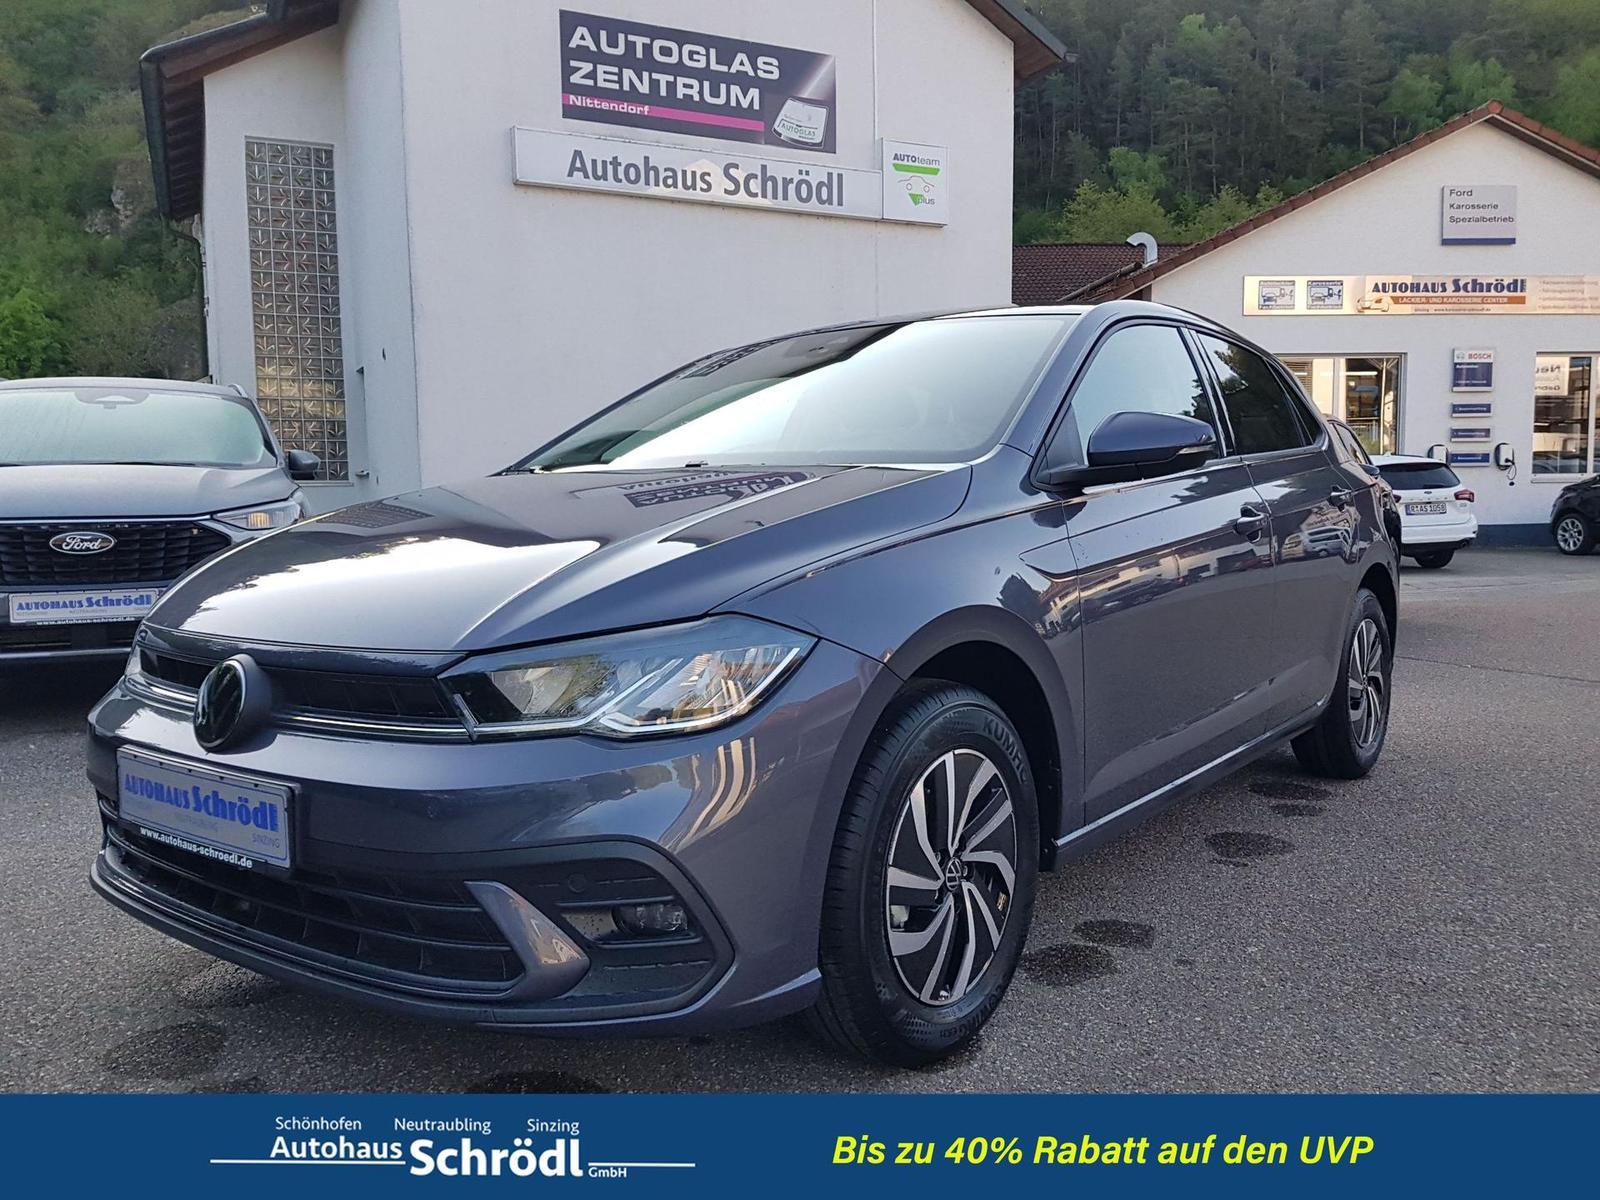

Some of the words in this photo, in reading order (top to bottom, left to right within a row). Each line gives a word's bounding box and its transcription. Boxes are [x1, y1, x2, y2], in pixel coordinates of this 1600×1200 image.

[568, 26, 780, 80] AUTOGLAS
[569, 60, 760, 111] ZENTRUM
[569, 94, 650, 116] Nittendorf
[567, 149, 713, 194] Autohaus
[723, 162, 845, 208] Schrödl
[1449, 189, 1473, 198] Ford
[1449, 202, 1499, 211] Karosserie
[1449, 215, 1515, 225] Spezialbetrieb
[1372, 282, 1447, 294] AUTOHAUS
[1452, 278, 1524, 294] Schrödl
[62, 536, 101, 551] Ford
[16, 600, 84, 611] AUTOHAUS
[85, 594, 152, 608] Schrödl
[124, 774, 191, 810] AUTOHAUS
[192, 785, 279, 833] Schrödl
[140, 826, 253, 869] www.autohaus-schroedl.de
